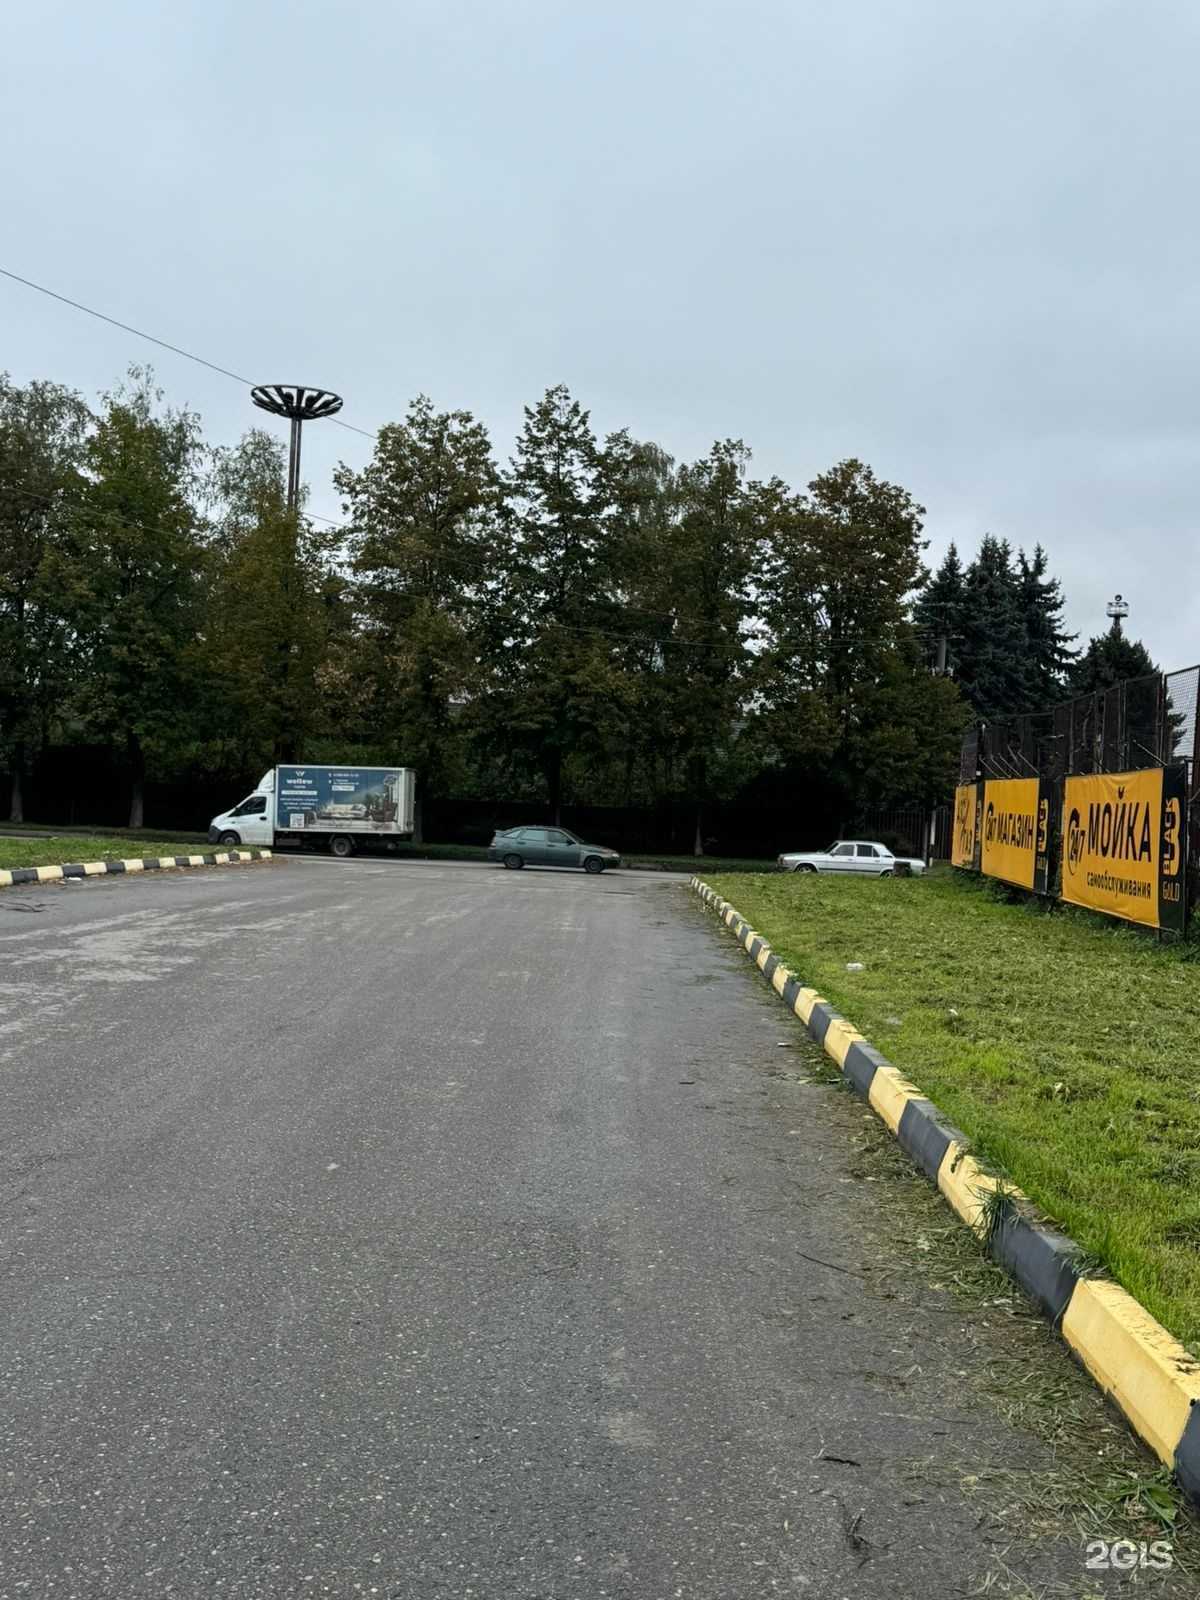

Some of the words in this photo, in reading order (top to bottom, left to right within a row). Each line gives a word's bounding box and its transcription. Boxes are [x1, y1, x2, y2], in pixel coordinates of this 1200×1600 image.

[998, 812, 1033, 850] МАГАЗИН
[1088, 787, 1152, 863] МОЙКА
[1163, 799, 1178, 876] BLACK
[1087, 870, 1151, 900] самообслуживания
